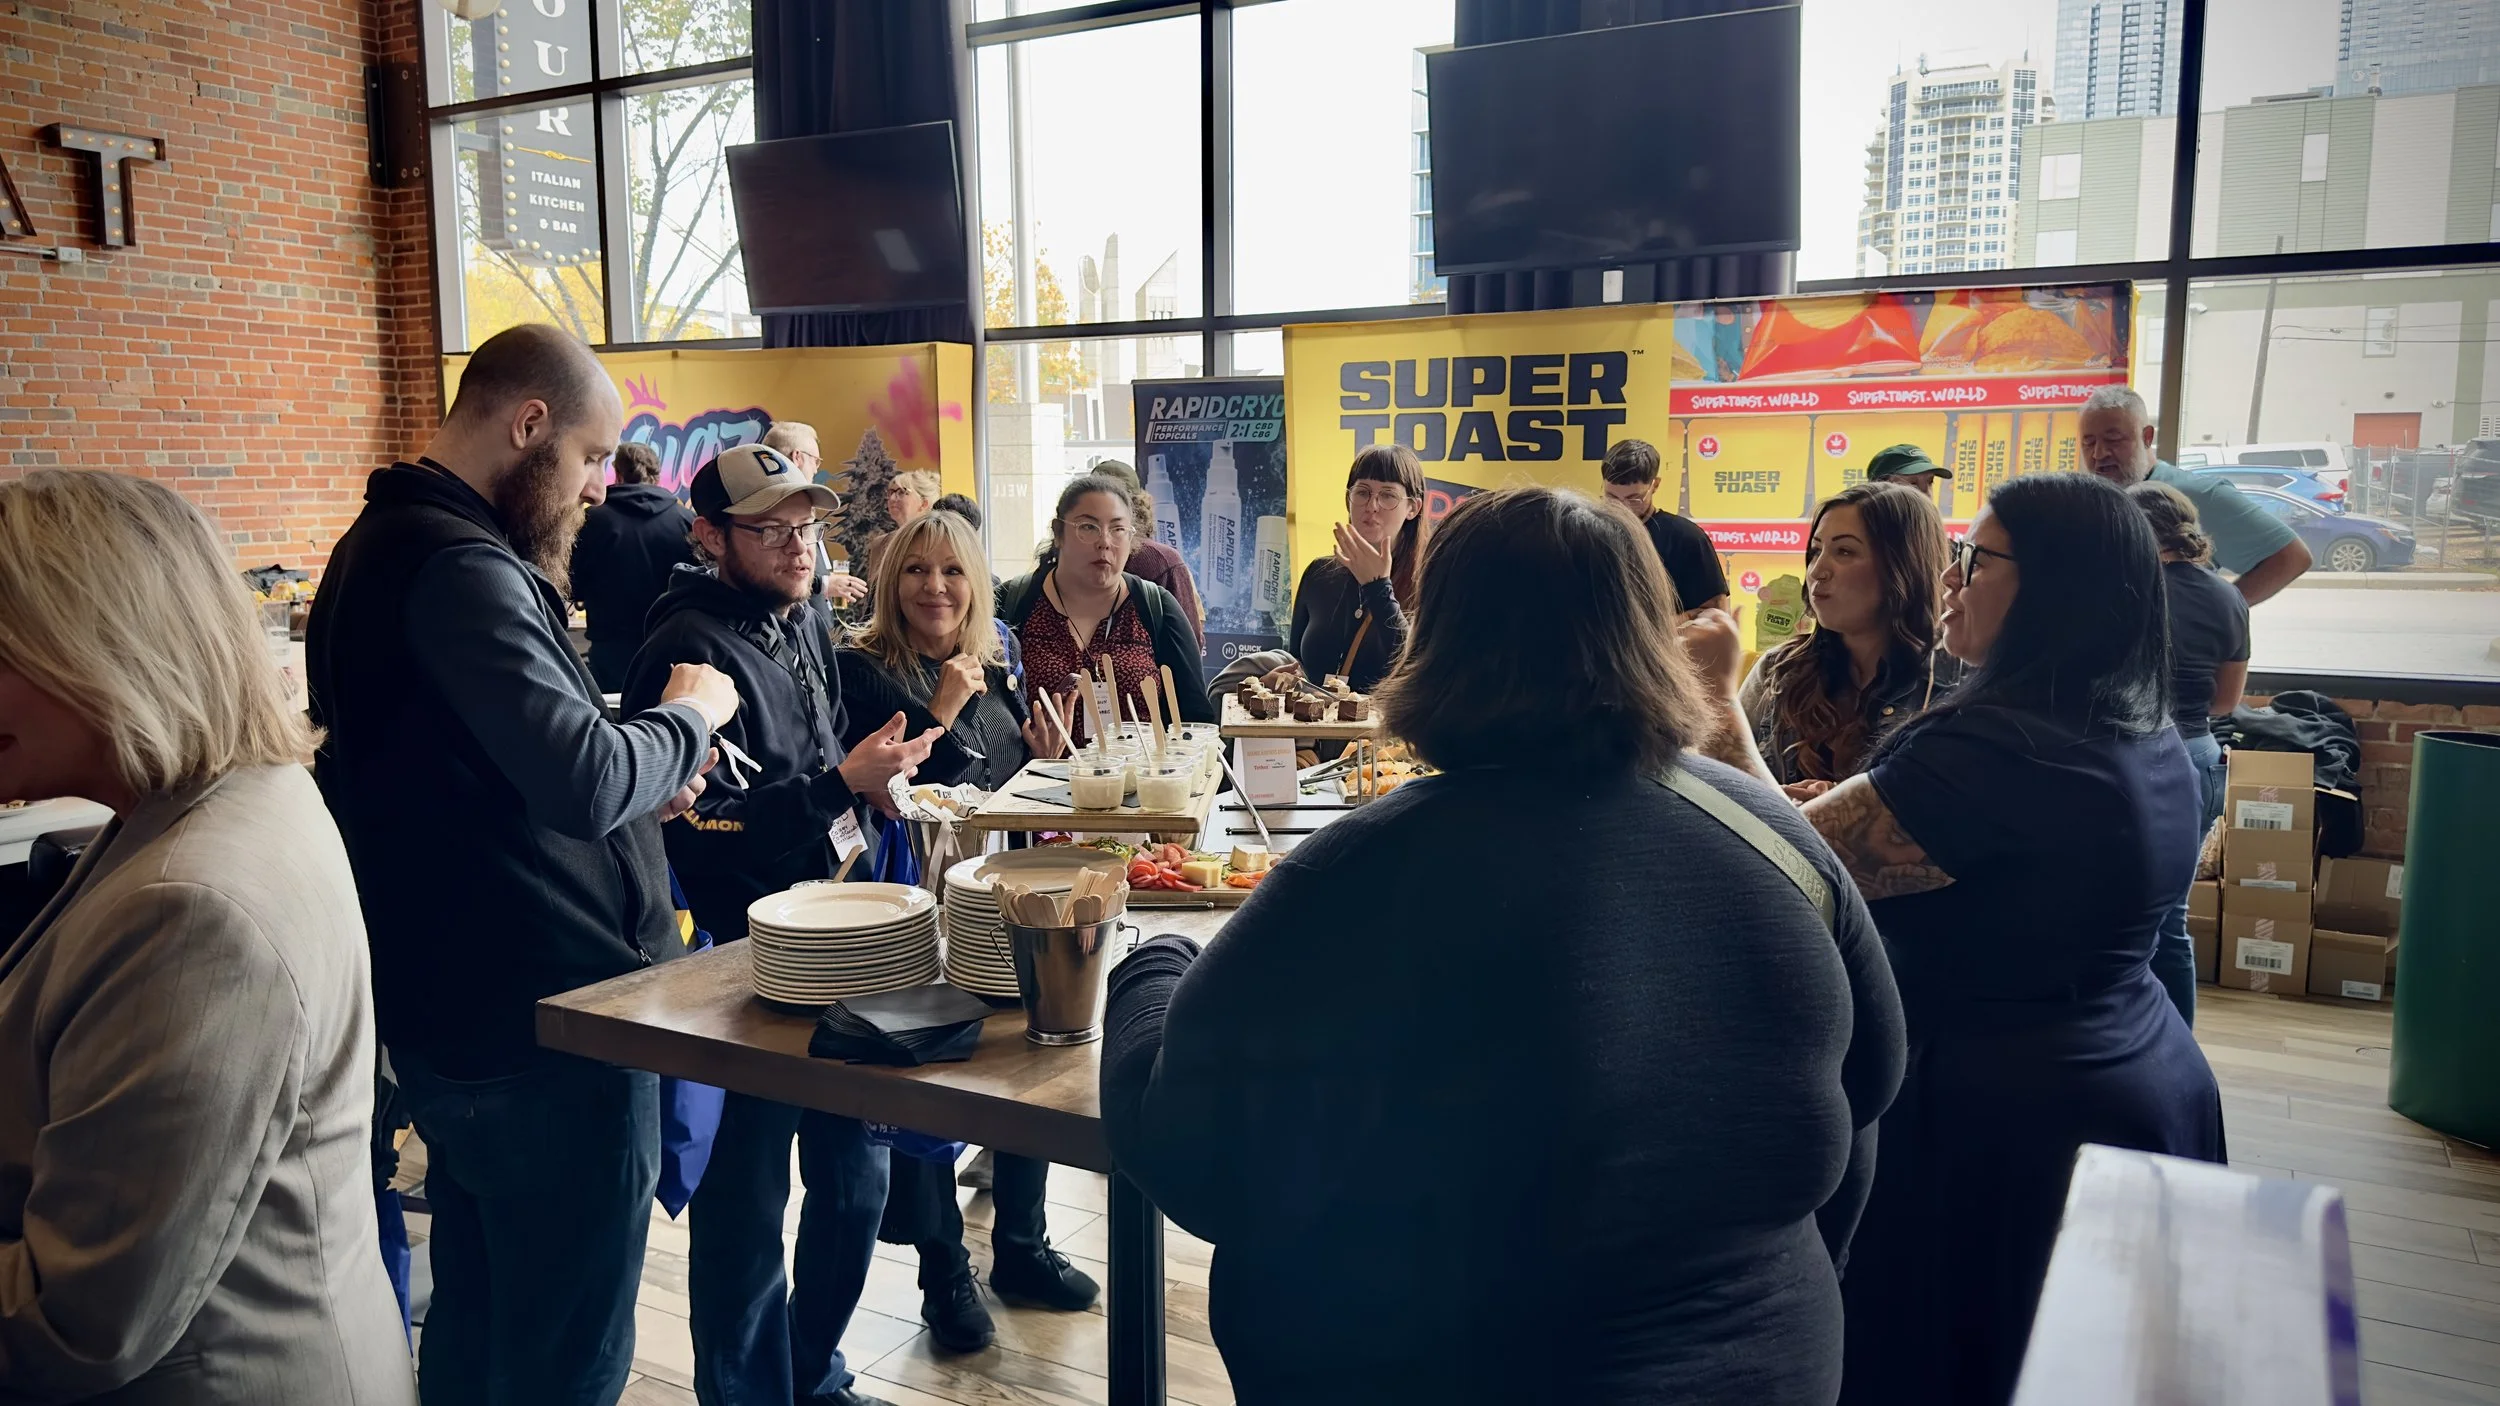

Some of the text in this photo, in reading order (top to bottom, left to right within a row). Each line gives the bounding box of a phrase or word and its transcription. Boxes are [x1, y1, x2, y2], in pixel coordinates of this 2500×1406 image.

[531, 170, 581, 190] ITALIAN
[529, 193, 585, 213] KITCHEN
[539, 218, 577, 234] & BAR
[1340, 350, 1628, 411] SUPER
[1690, 391, 1819, 409] SUPERTOAST.WORLD
[1847, 386, 1988, 405] SUPERTOAST.WORLD
[1153, 432, 1197, 440] TOPICALS
[1155, 424, 1224, 433] PERFORMANCE
[1255, 422, 1273, 430] CBD
[1340, 408, 1627, 462] TOAST
[1956, 439, 1968, 493] TOAST
[1965, 439, 1977, 493] SUPER
[1714, 470, 1780, 483] SUPER
[1714, 482, 1780, 493] TOAST
[1224, 518, 1236, 588] RAPIDCRYO
[1270, 551, 1281, 604] RAPIDCRYO
[1238, 644, 1262, 652] QUICK
